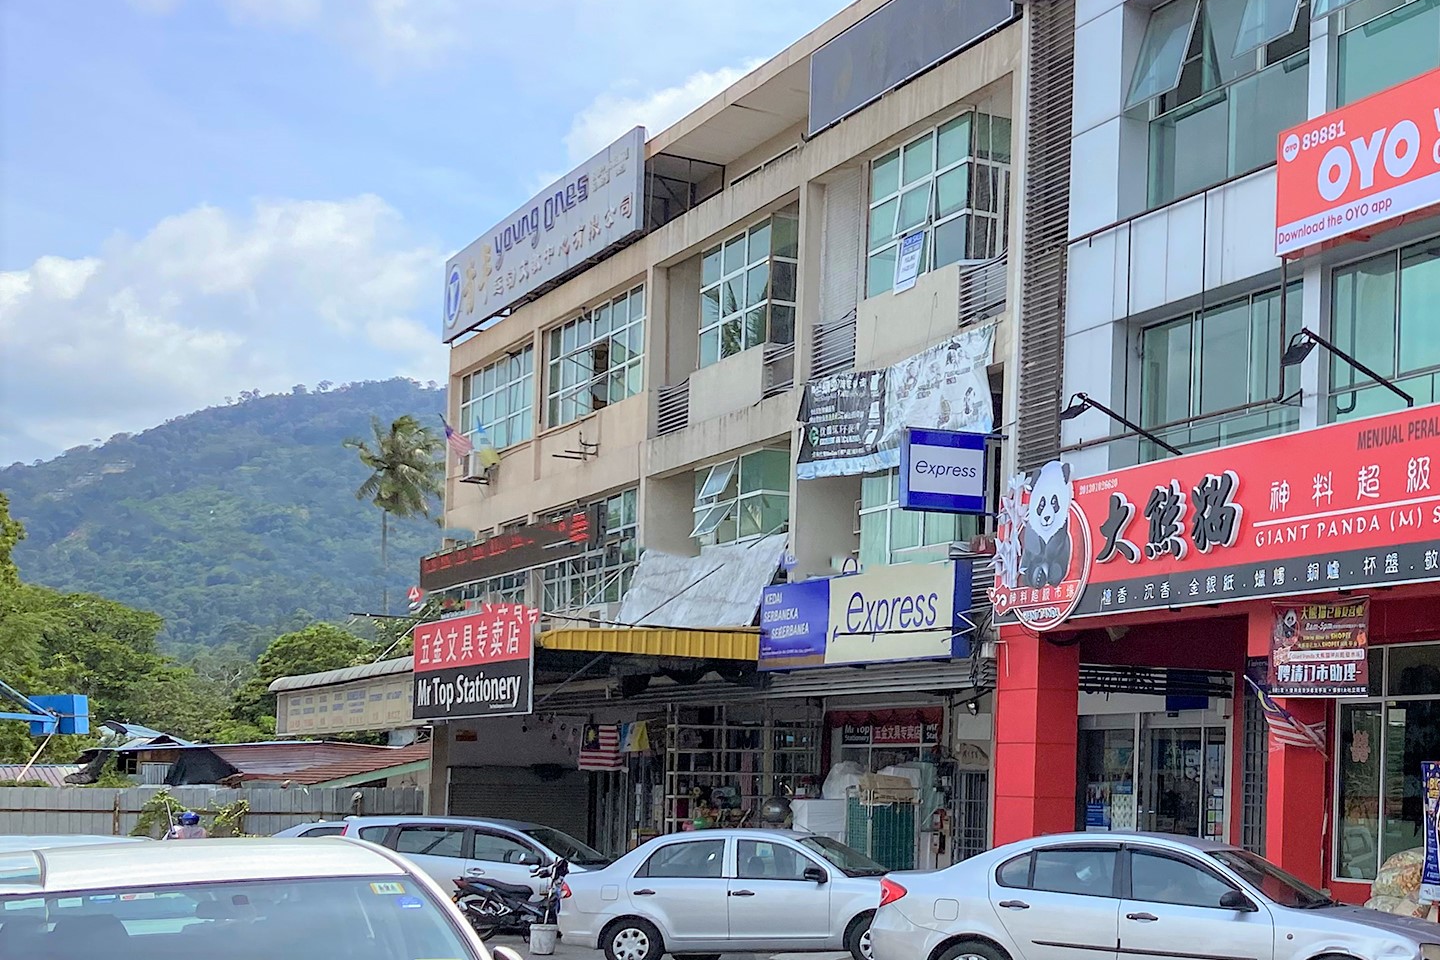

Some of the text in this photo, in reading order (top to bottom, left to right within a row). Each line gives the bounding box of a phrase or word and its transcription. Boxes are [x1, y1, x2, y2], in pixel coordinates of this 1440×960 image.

[1302, 120, 1346, 151] 89881
[1317, 119, 1420, 202] OYO
[1278, 198, 1392, 245] Download the OYO app
[1356, 423, 1404, 451] MENJUAL
[916, 460, 976, 478] express
[1255, 522, 1310, 547] GIANT
[1317, 512, 1381, 541] PANDA
[1389, 507, 1424, 533] (M)
[847, 591, 939, 642] express
[419, 616, 521, 664] 五金文具专卖店
[417, 678, 431, 706] Mr
[433, 677, 454, 712] Top
[457, 671, 521, 708] Stationery
